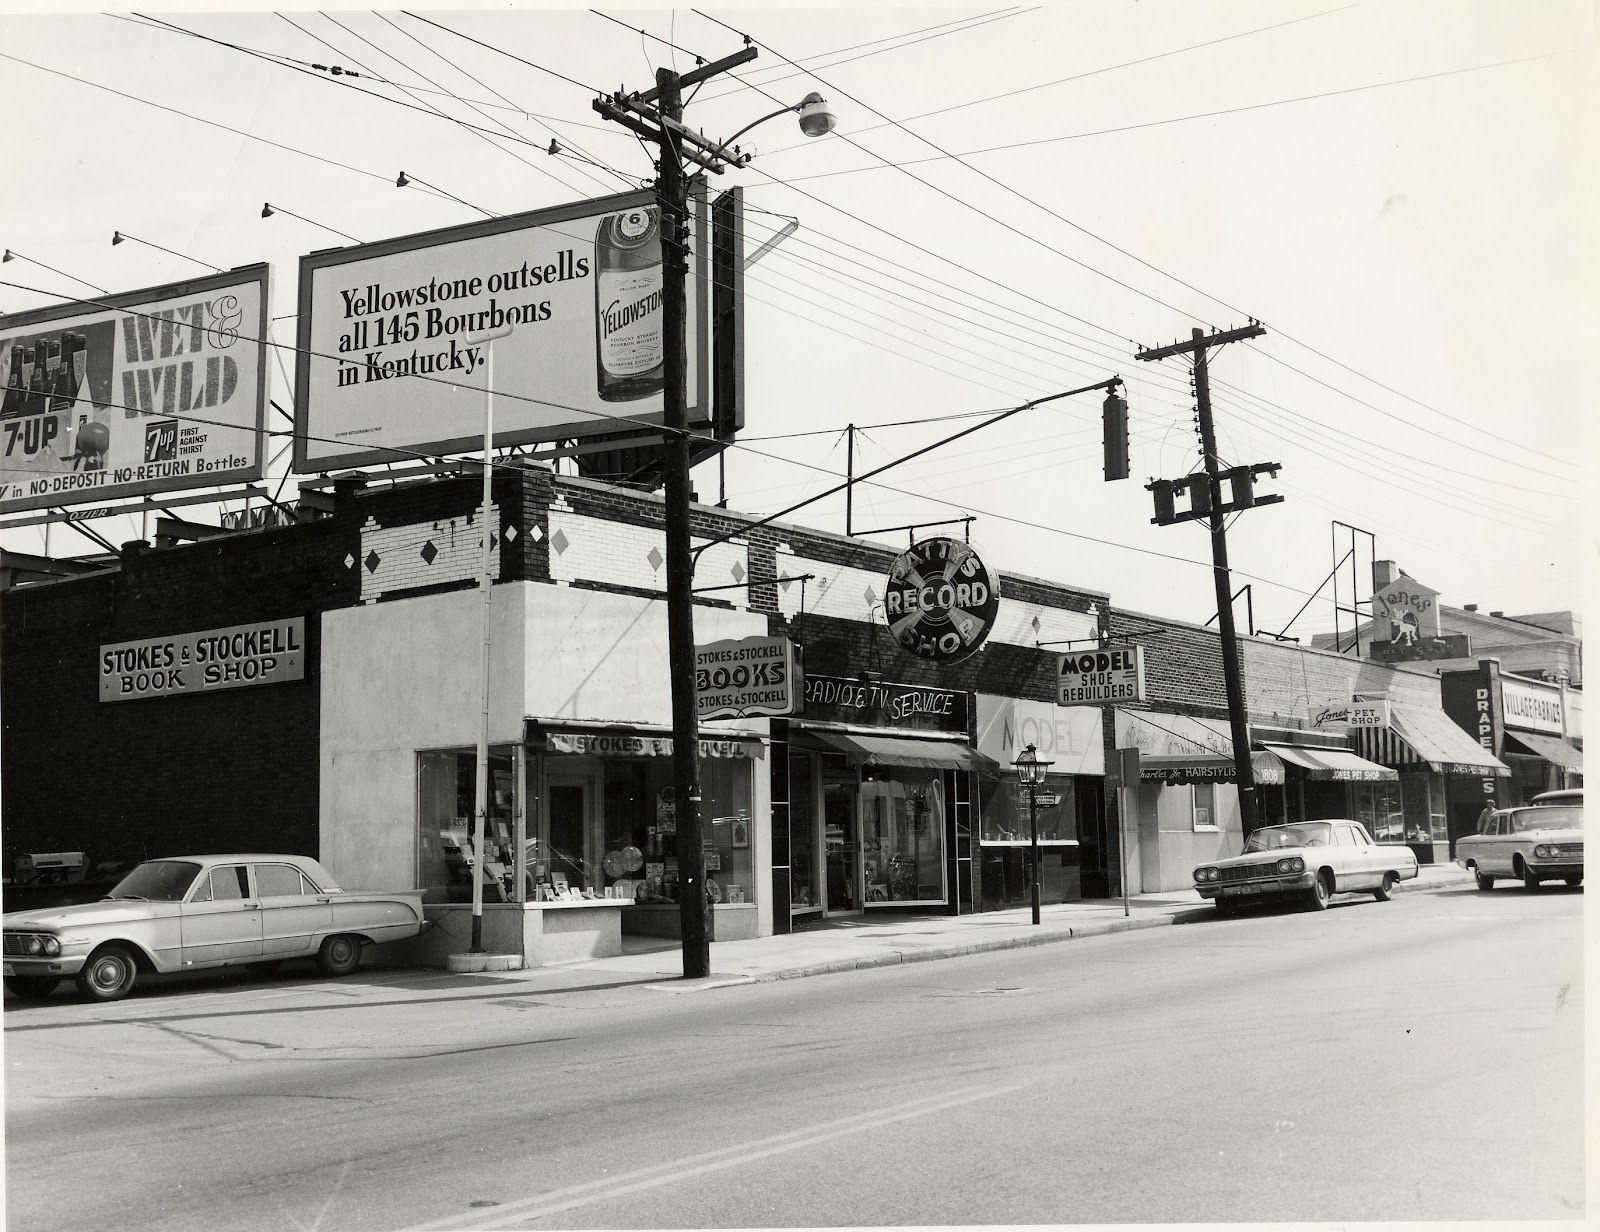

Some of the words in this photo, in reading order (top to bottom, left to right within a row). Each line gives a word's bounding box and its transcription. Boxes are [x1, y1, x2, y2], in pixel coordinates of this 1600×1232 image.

[628, 213, 642, 225] 6
[340, 276, 482, 319] Yellowstone
[487, 249, 590, 293] outsells
[122, 301, 212, 364] WET
[207, 295, 243, 350] &
[338, 320, 369, 353] all
[374, 311, 420, 347] 145
[425, 299, 552, 339] Bourbons
[337, 359, 359, 388] in
[364, 340, 485, 384] Kentucky.
[121, 355, 239, 420] WILD
[179, 434, 208, 447] AGAINST
[180, 427, 199, 437] FIRST
[179, 444, 203, 455] THIRST
[12, 485, 23, 498] in
[196, 453, 248, 473] Bottles
[887, 582, 988, 615] RECORD
[1379, 591, 1432, 616] Jones
[899, 618, 974, 656] SHOP
[102, 643, 175, 675] STOKES
[180, 645, 191, 667] &
[195, 626, 300, 664] STOCKELL
[697, 650, 732, 665] STOKES
[733, 651, 739, 661] &
[739, 645, 784, 661] STOCKELL
[120, 669, 186, 695] BOOK
[204, 657, 278, 687] SHOP
[1061, 651, 1134, 676] MODEL
[696, 661, 785, 692] BOOKS
[1081, 672, 1113, 687] SHOE
[698, 694, 733, 708] STOKES
[734, 696, 740, 705] &
[740, 690, 786, 705] STOCKELL
[869, 686, 889, 708] TV
[891, 692, 955, 720] SERVICE
[1063, 683, 1133, 702] REBUILDERS
[1351, 716, 1381, 725] SHOP
[1354, 709, 1376, 717] PET
[1504, 692, 1533, 719] VILLAGE
[1533, 698, 1561, 724] FABRICS
[576, 737, 644, 752] STOKES
[1002, 715, 1083, 757] MODEL
[1476, 688, 1496, 794] DRAPES
[1185, 767, 1237, 778] HAIRSTYLIS
[1261, 768, 1278, 781] 1808
[1332, 770, 1351, 780] JONES
[1352, 771, 1362, 780] PET
[1364, 771, 1380, 780] SHOP
